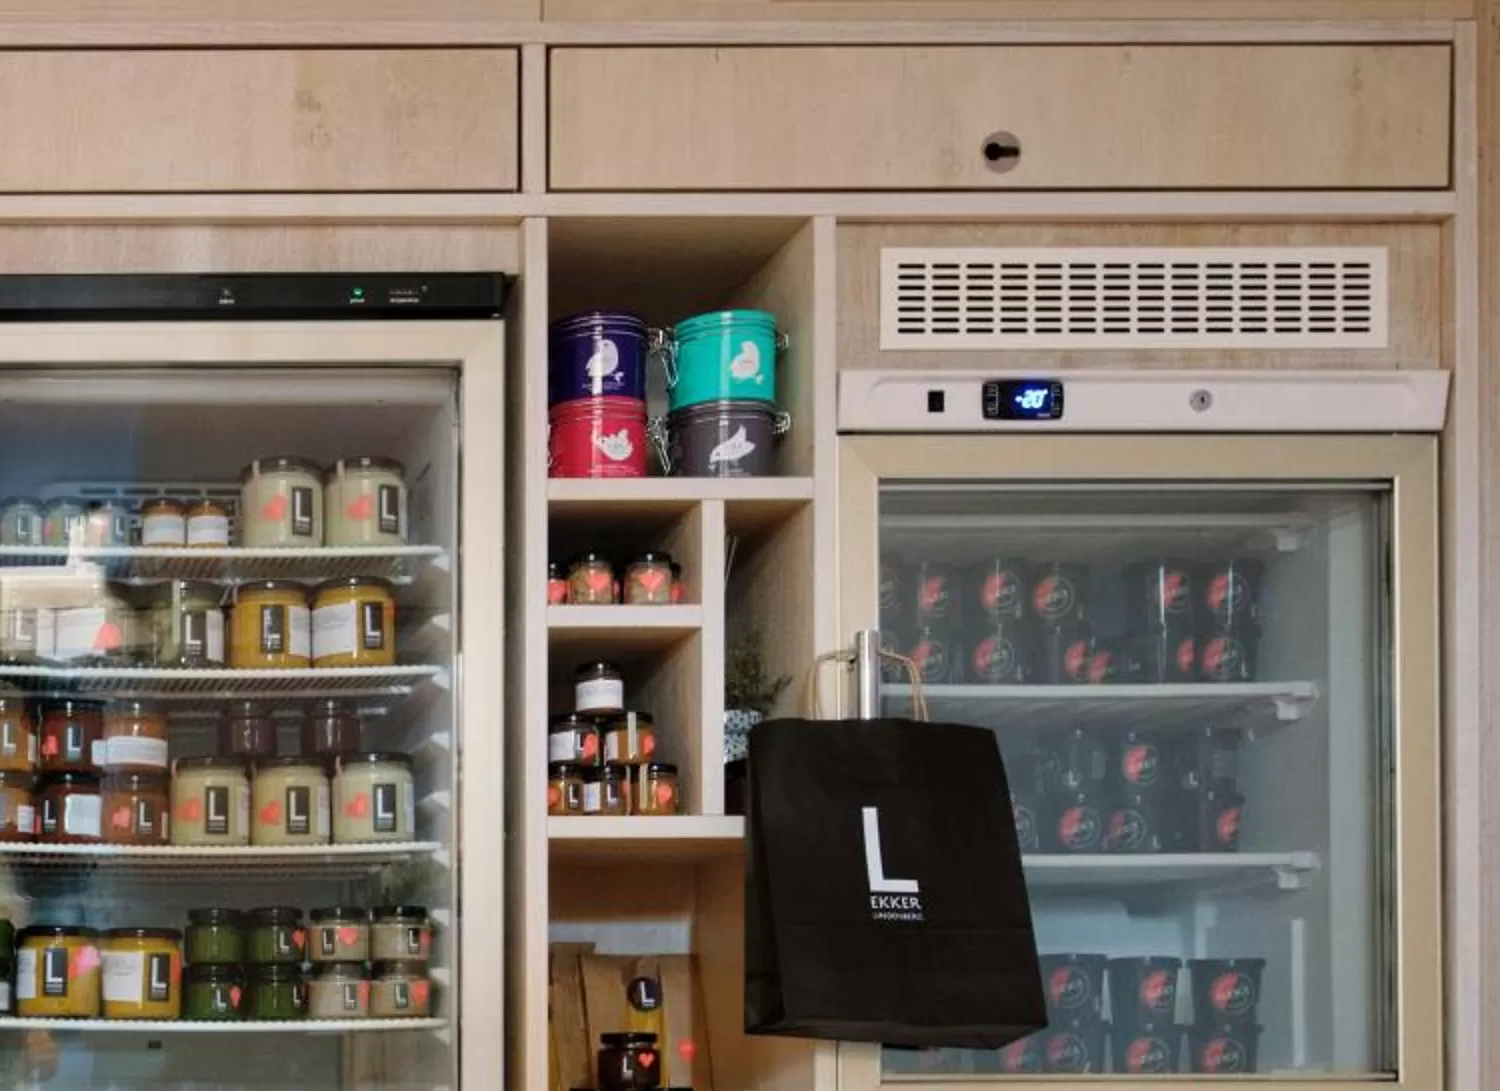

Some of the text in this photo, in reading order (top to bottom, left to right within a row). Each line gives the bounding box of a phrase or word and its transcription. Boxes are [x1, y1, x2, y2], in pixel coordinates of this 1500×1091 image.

[295, 491, 308, 522] L
[382, 489, 395, 522] L
[186, 613, 201, 645] L
[264, 609, 280, 642] L
[366, 605, 380, 638] L
[67, 726, 80, 751] L
[139, 801, 152, 827] L
[209, 791, 225, 821] L
[290, 791, 306, 821] L
[377, 788, 393, 819] L
[861, 806, 919, 893] L
[870, 895, 922, 909] EKKER
[47, 953, 62, 984] L
[152, 957, 166, 990] L
[640, 981, 654, 1003] L
